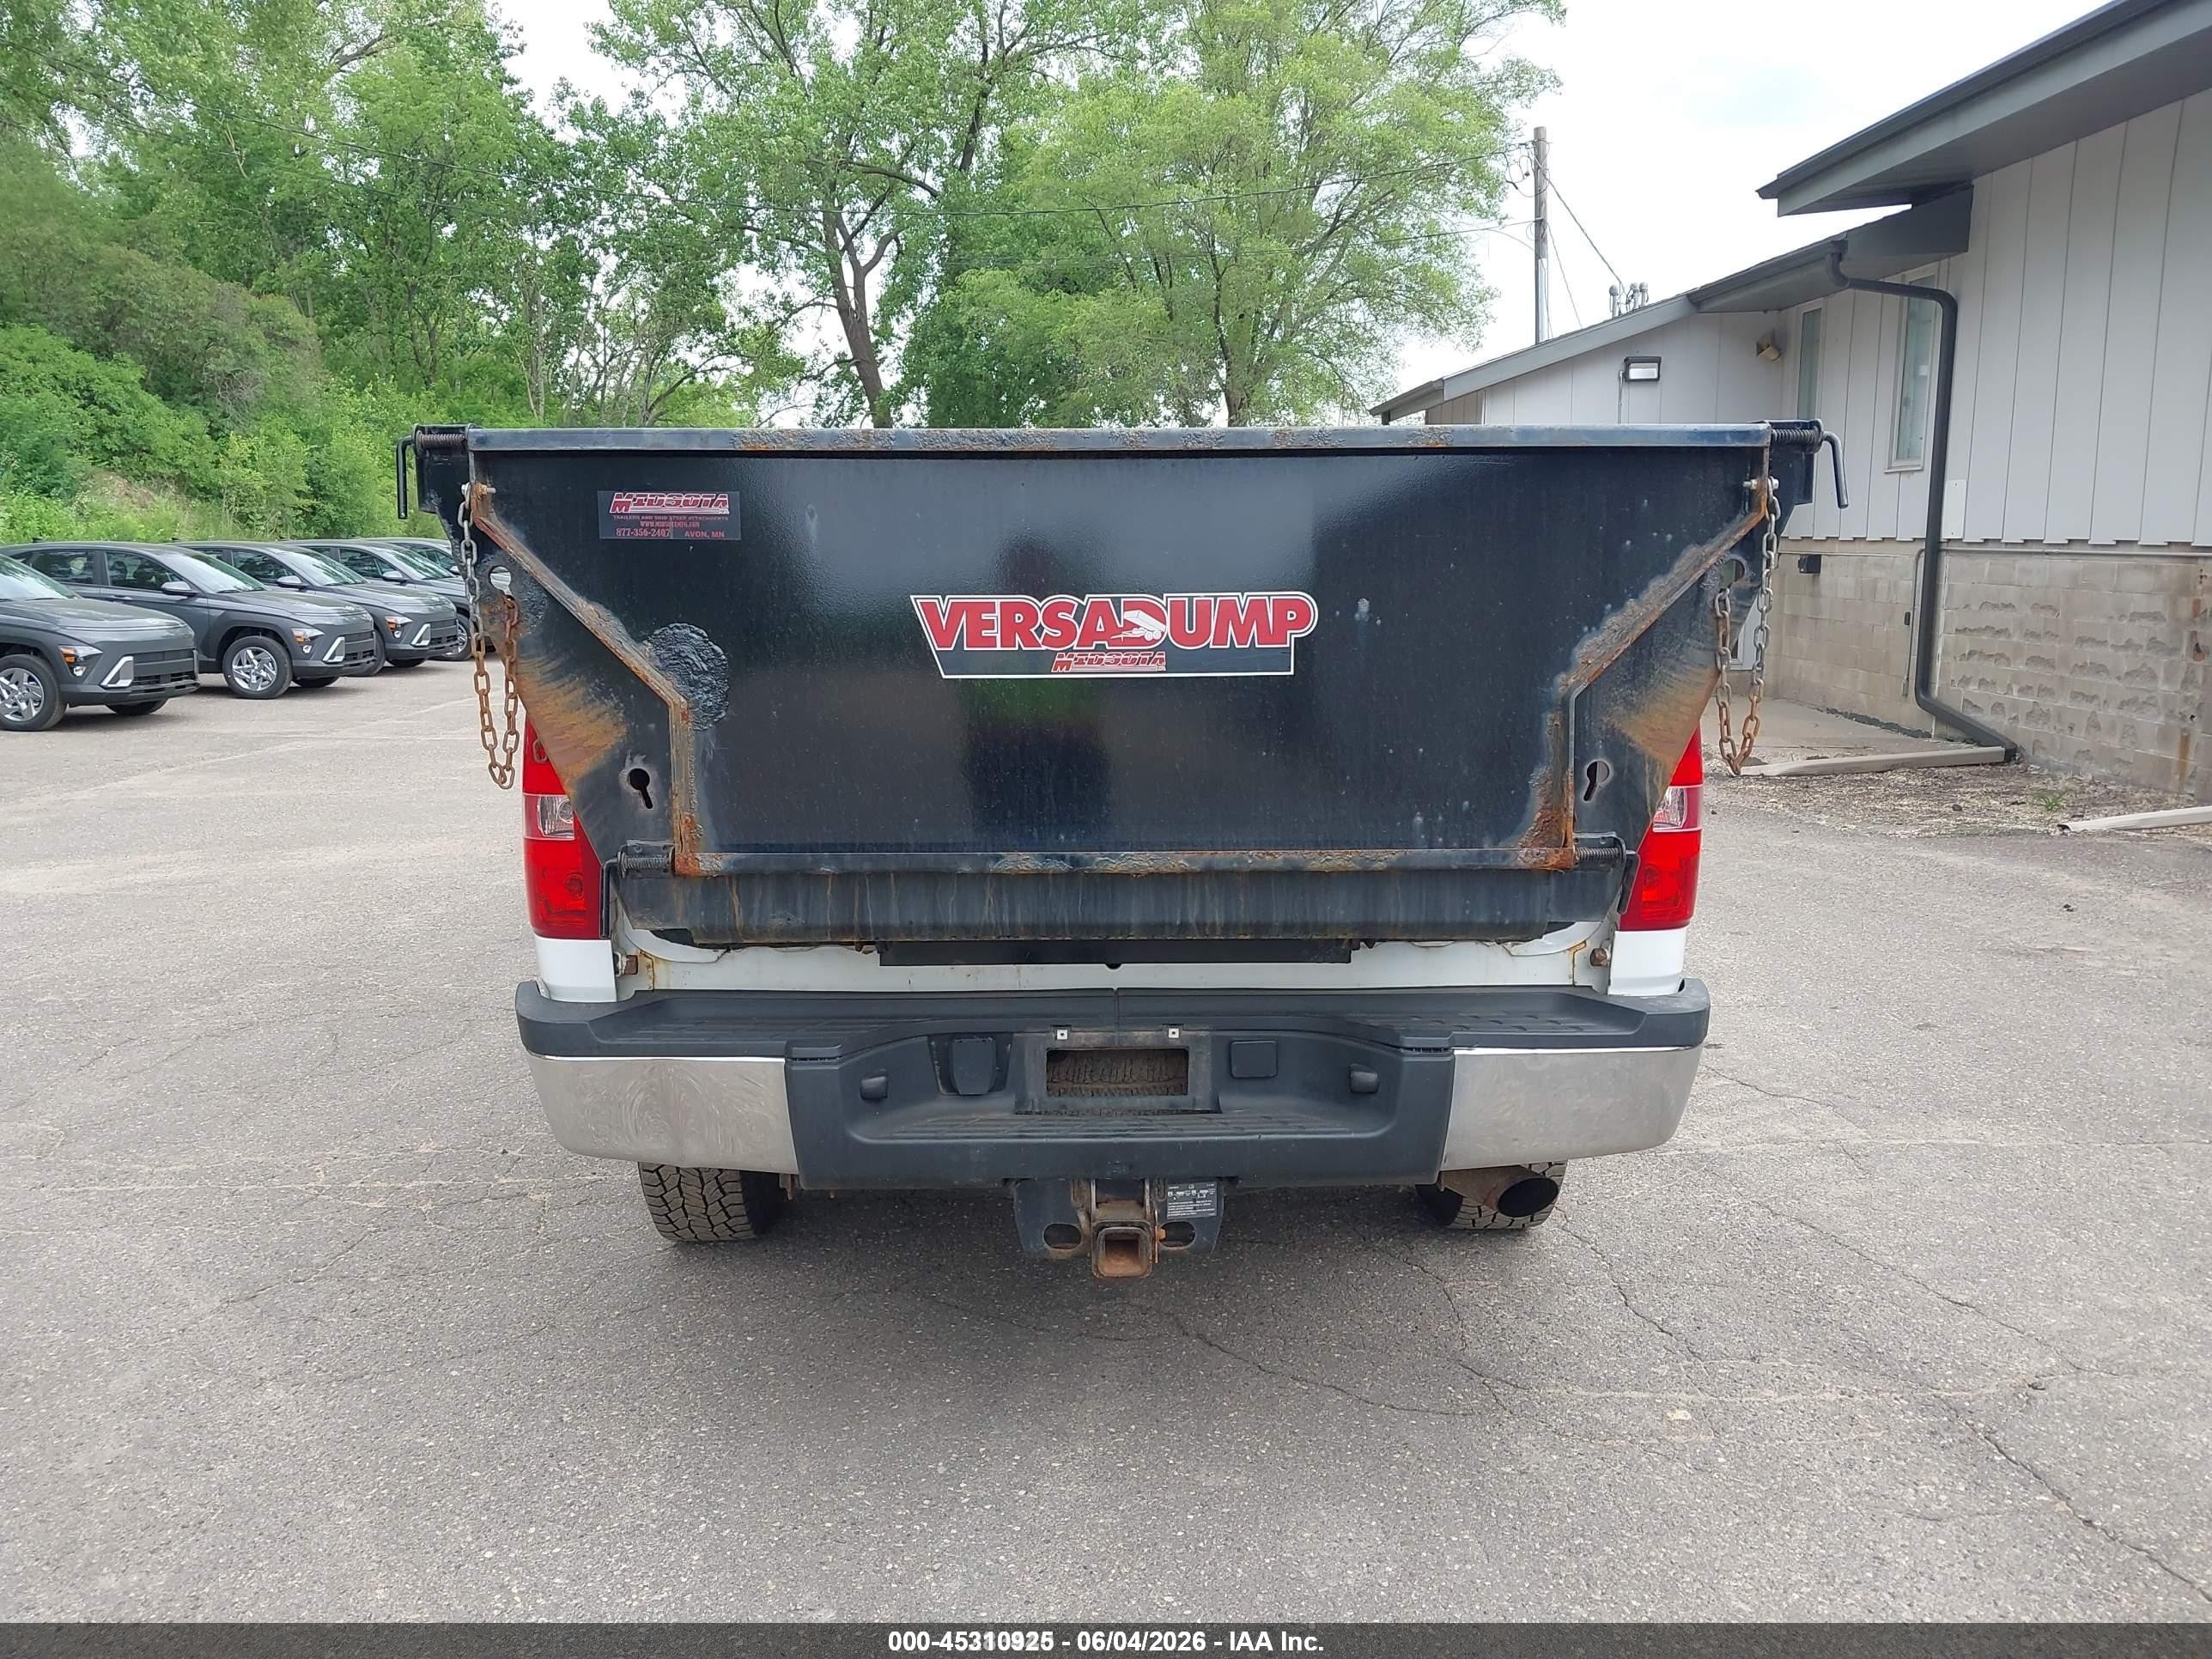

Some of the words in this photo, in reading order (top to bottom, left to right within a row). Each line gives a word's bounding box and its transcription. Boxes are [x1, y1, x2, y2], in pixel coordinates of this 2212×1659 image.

[610, 492, 729, 514] MIDSOTA
[915, 597, 1313, 649] VERSADUMP
[1051, 652, 1166, 672] MIDSOTA
